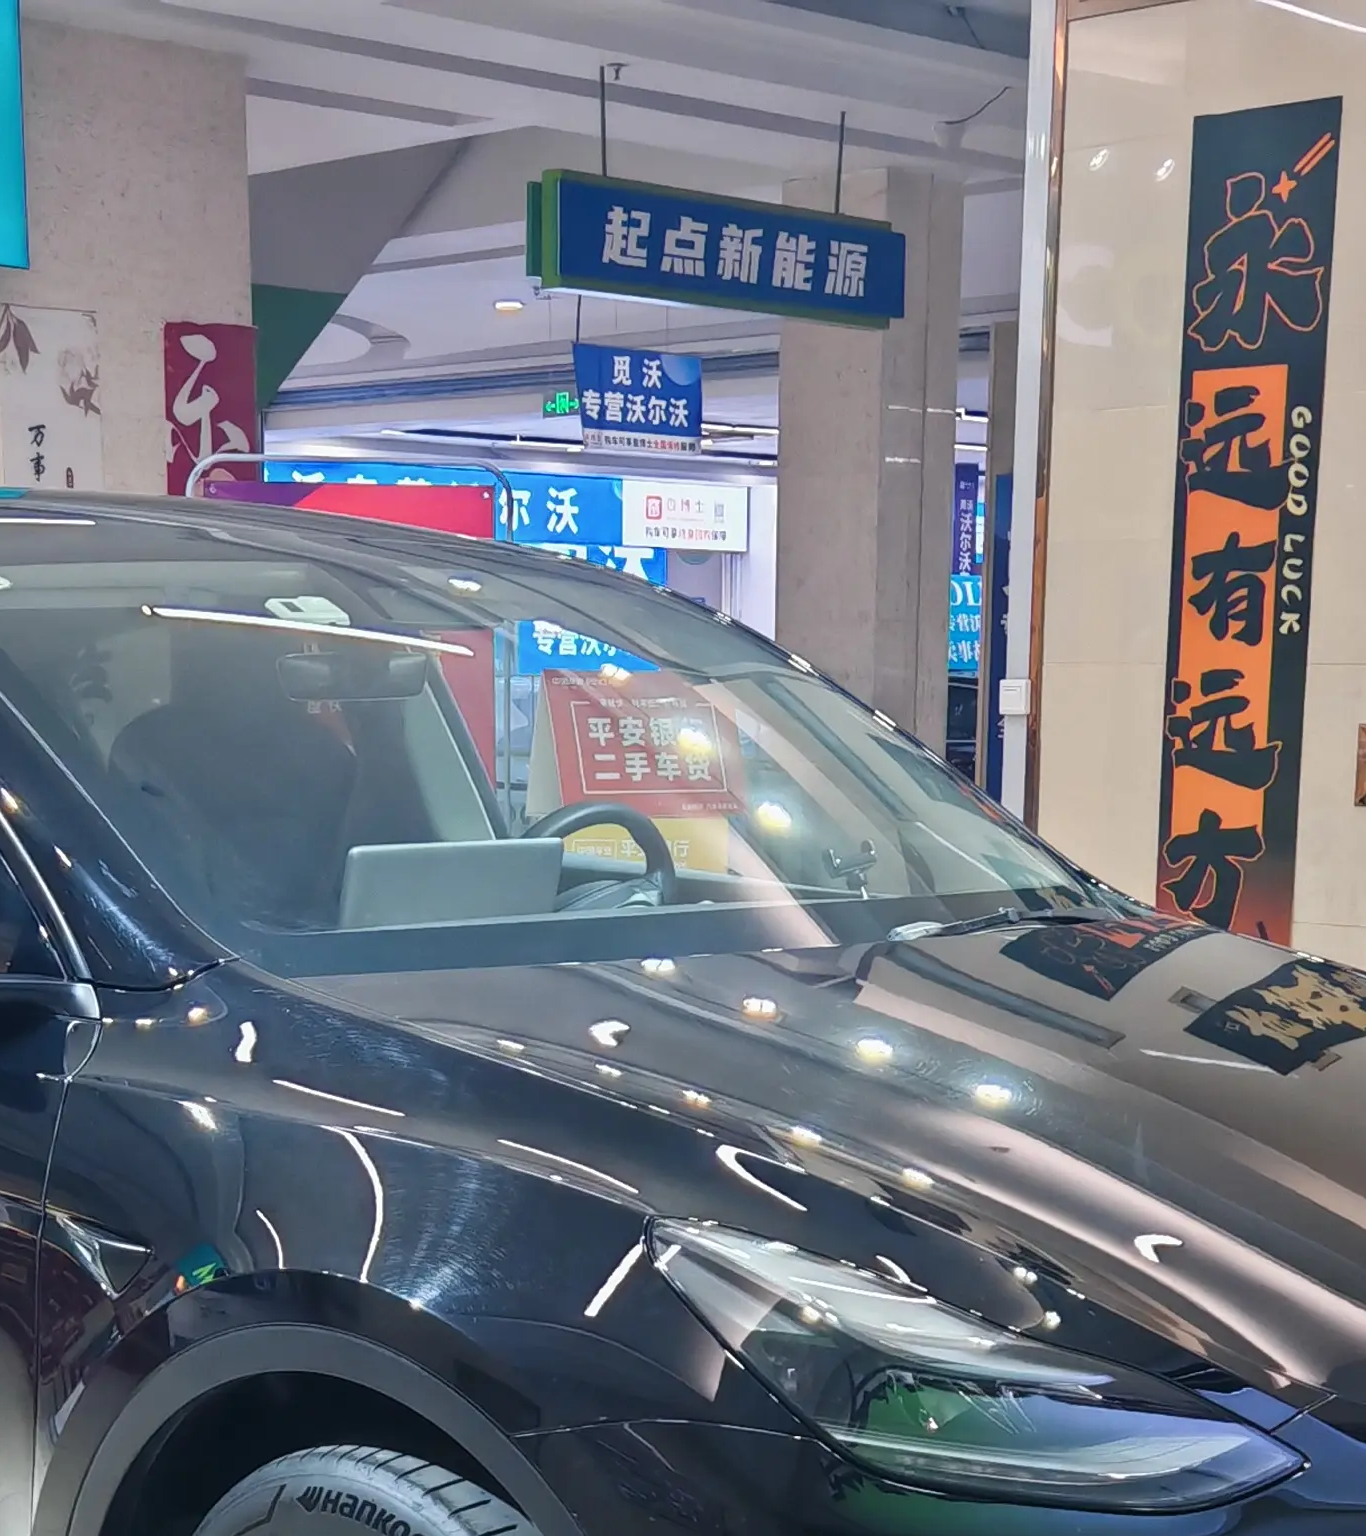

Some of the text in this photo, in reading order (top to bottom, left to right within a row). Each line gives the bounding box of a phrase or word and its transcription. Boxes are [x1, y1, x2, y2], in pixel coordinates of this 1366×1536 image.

[601, 205, 870, 298] 起点新能源
[612, 355, 663, 389] 觅沃
[582, 389, 689, 428] 专营沃尔沃
[959, 513, 973, 576] 沃尔沃
[1279, 405, 1312, 636] GOOD LUCK
[594, 751, 712, 782] 二手车贷
